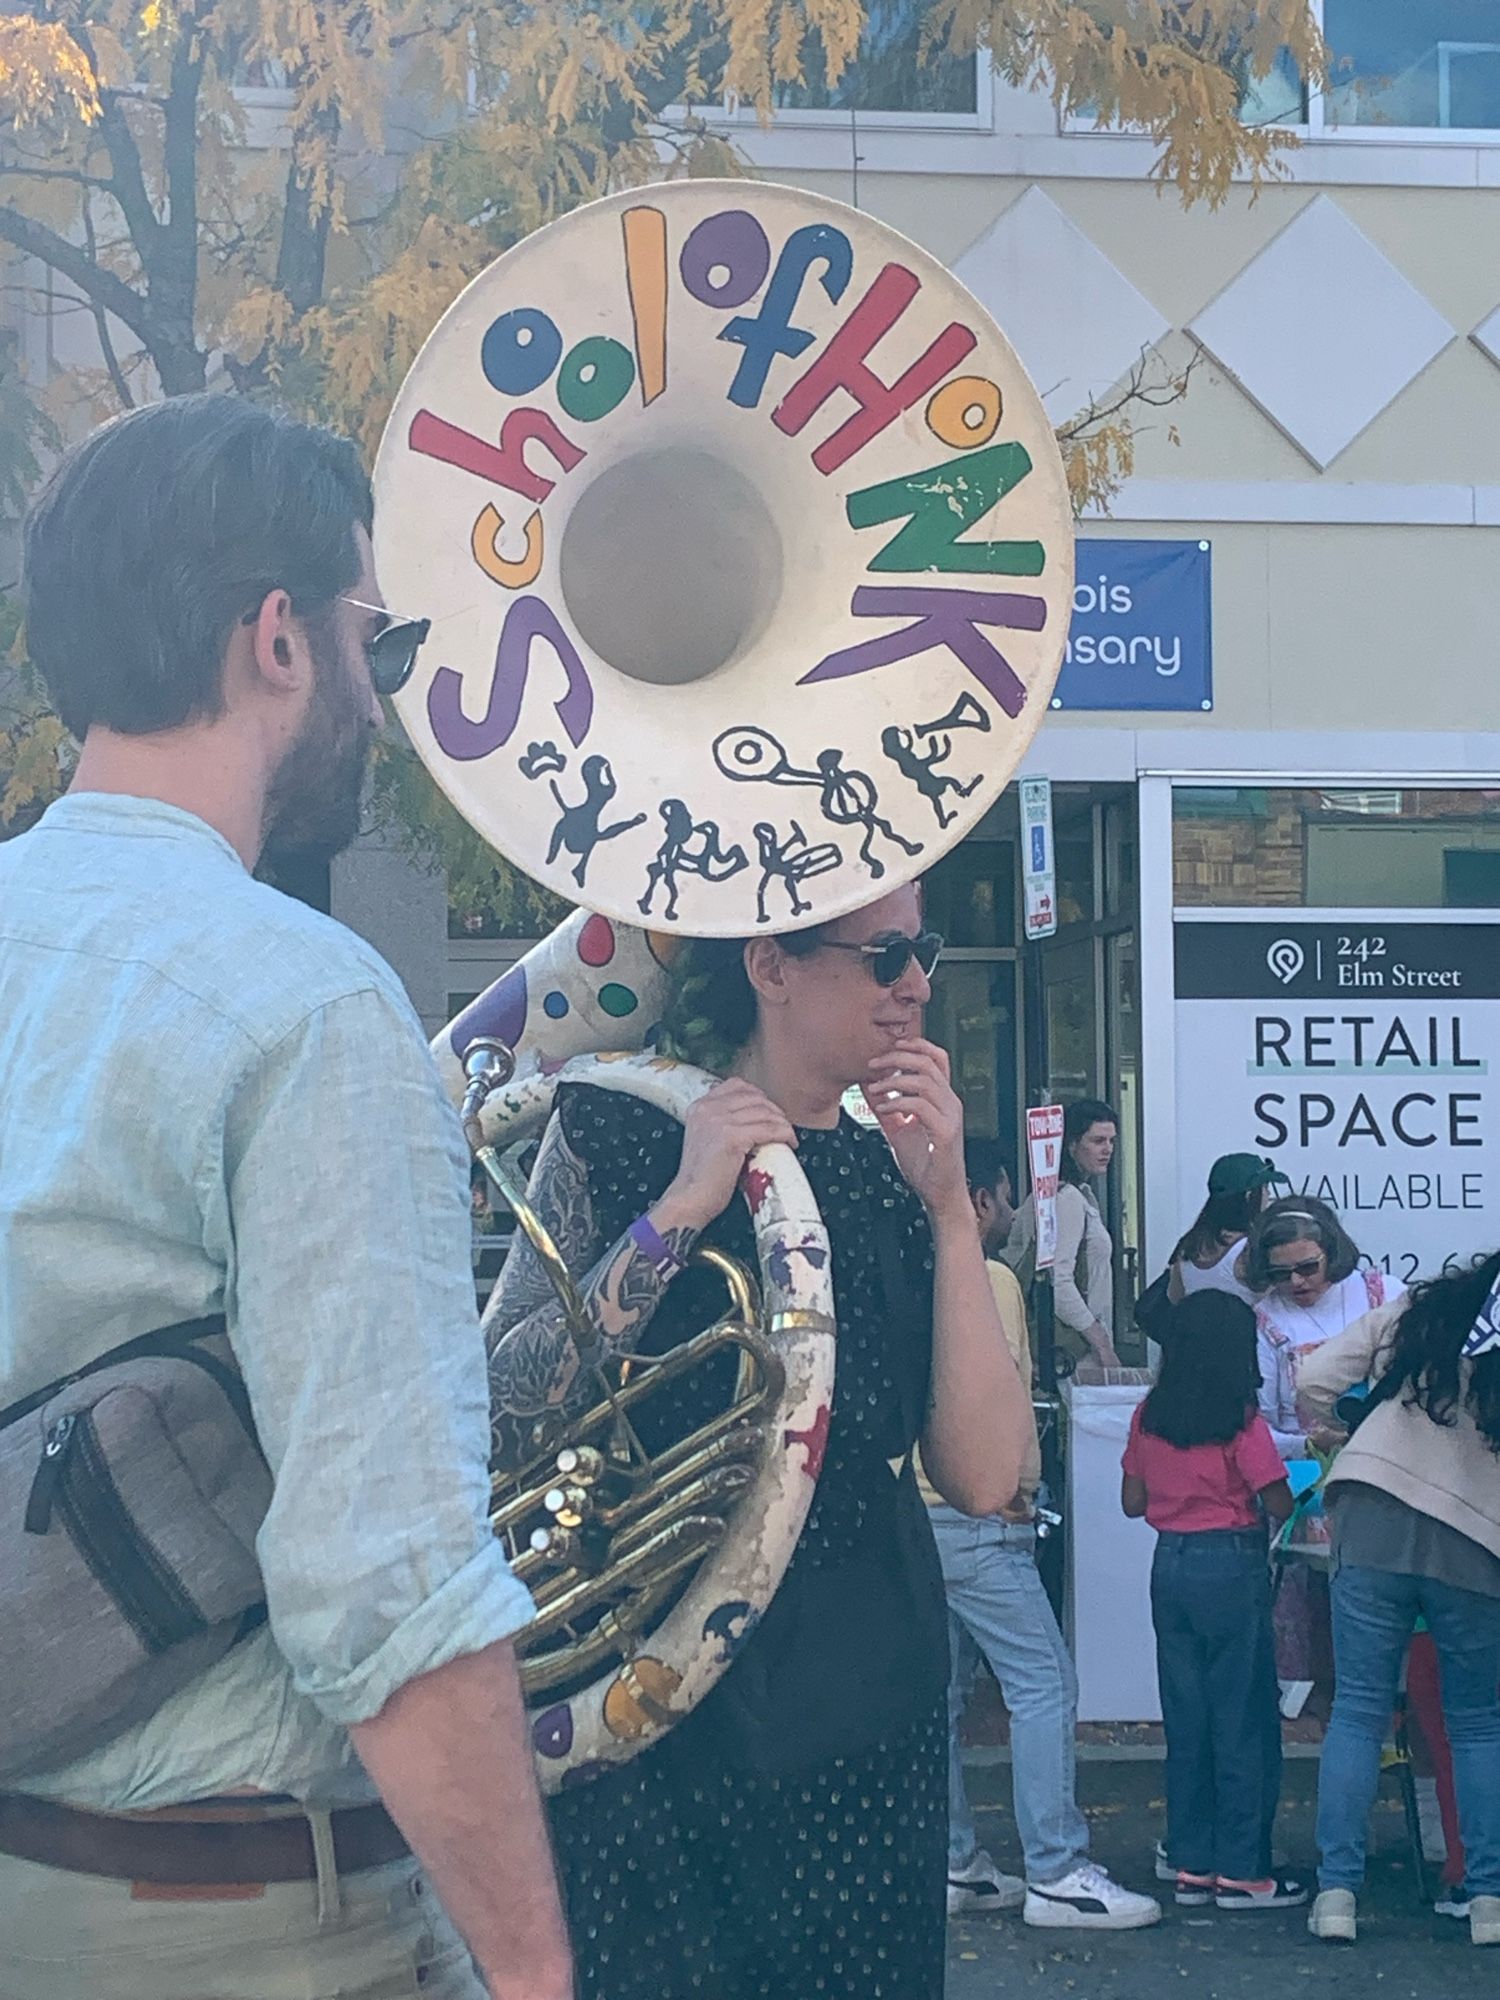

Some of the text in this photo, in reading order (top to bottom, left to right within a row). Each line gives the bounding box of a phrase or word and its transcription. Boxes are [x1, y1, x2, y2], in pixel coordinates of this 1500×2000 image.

[409, 206, 668, 761] School
[680, 210, 854, 409] of
[1337, 936, 1387, 963] 242
[1337, 961, 1463, 987] Elm Street
[1255, 1015, 1481, 1068] RETAIL
[1253, 1092, 1484, 1148] SPACE
